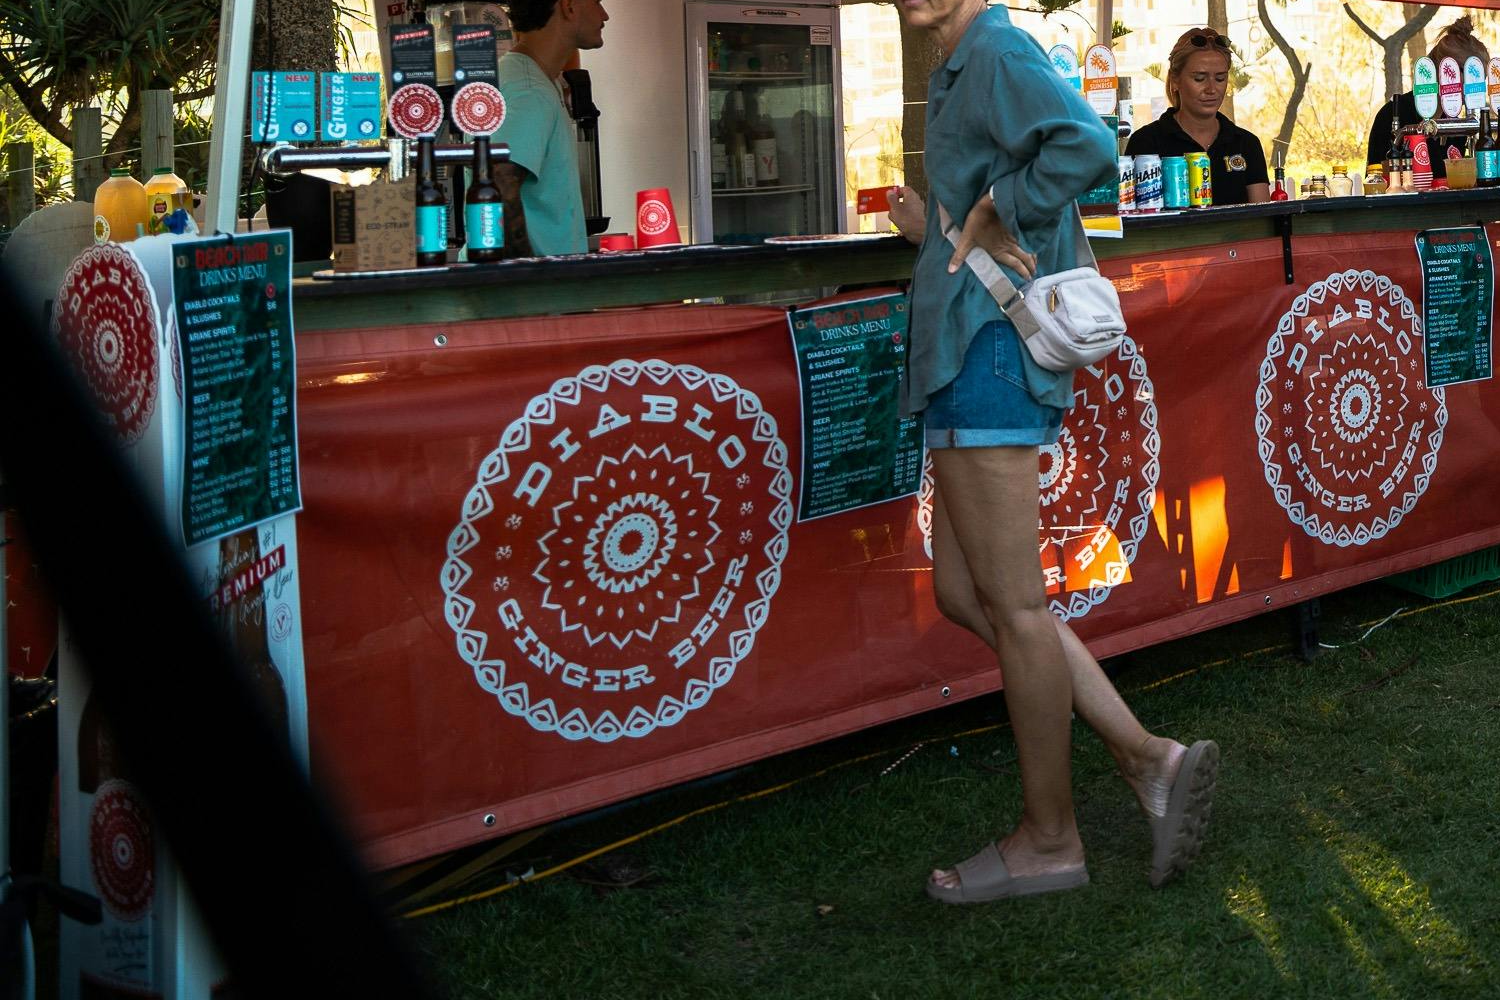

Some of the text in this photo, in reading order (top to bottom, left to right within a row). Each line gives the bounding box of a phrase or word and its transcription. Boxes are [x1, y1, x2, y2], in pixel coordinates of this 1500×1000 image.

[327, 75, 348, 138] GINGER
[69, 267, 144, 318] DIABLO
[198, 262, 267, 287] DRINKS MENU
[806, 341, 865, 360] DIABLO COCKTAILS
[819, 317, 891, 341] DRINKS MENU
[1287, 298, 1411, 375] DIABLO
[834, 365, 860, 377] SPIRITS
[513, 395, 746, 507] DIABLO
[1287, 419, 1425, 512] GINGER BEER
[1074, 476, 1131, 572] BEER
[210, 551, 281, 613] REMIUM
[498, 554, 749, 692] GINGER BEER
